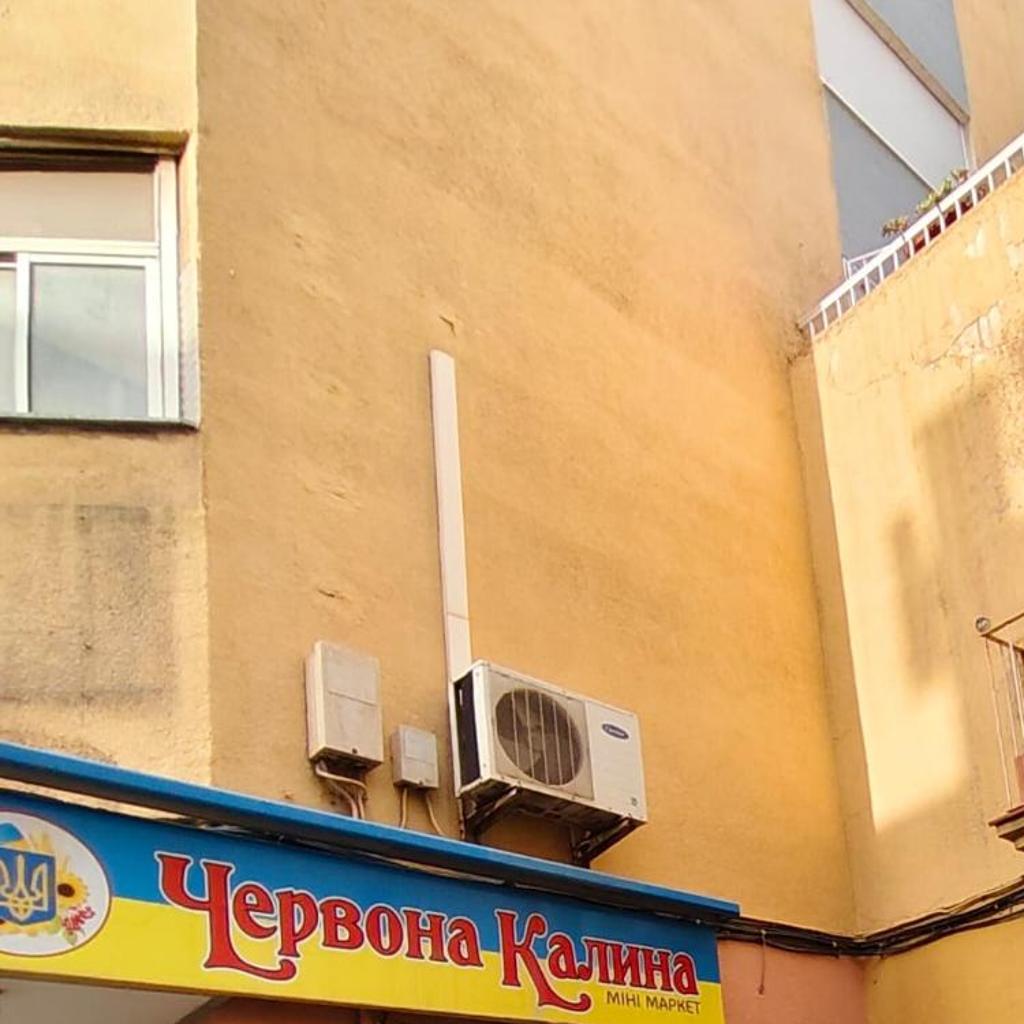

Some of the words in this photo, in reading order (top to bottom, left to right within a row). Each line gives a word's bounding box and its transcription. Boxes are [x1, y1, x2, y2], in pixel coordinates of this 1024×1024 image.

[155, 852, 485, 982] Червона
[496, 910, 700, 1013] Калина
[606, 990, 641, 1008] МІНІ
[646, 997, 701, 1015] МАРКЕТ
